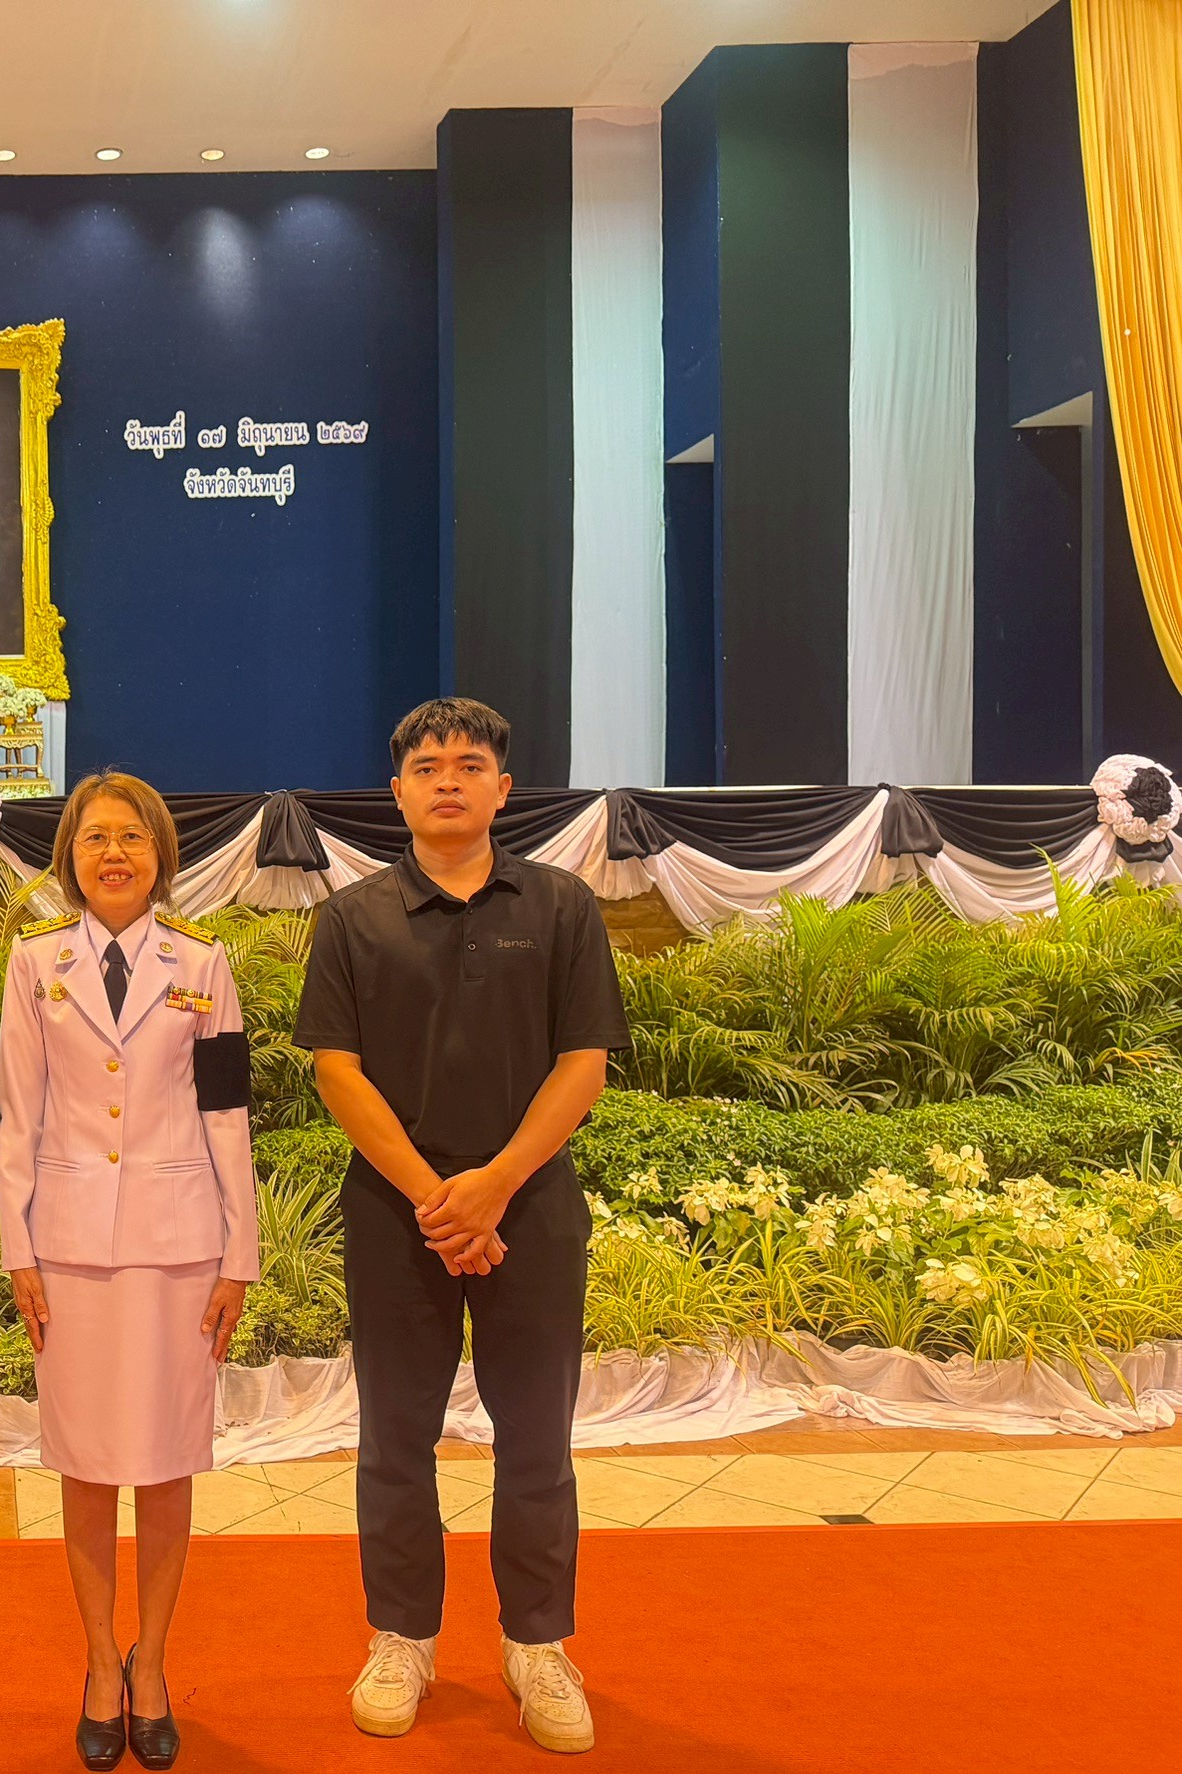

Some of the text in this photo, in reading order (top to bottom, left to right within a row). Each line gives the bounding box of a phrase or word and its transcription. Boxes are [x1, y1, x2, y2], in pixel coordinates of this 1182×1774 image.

[124, 410, 369, 460] วันพุธที่ ๑๗ มิถุนายน ๒๕๖๙
[183, 463, 296, 507] จังหวัดจันทบุรี
